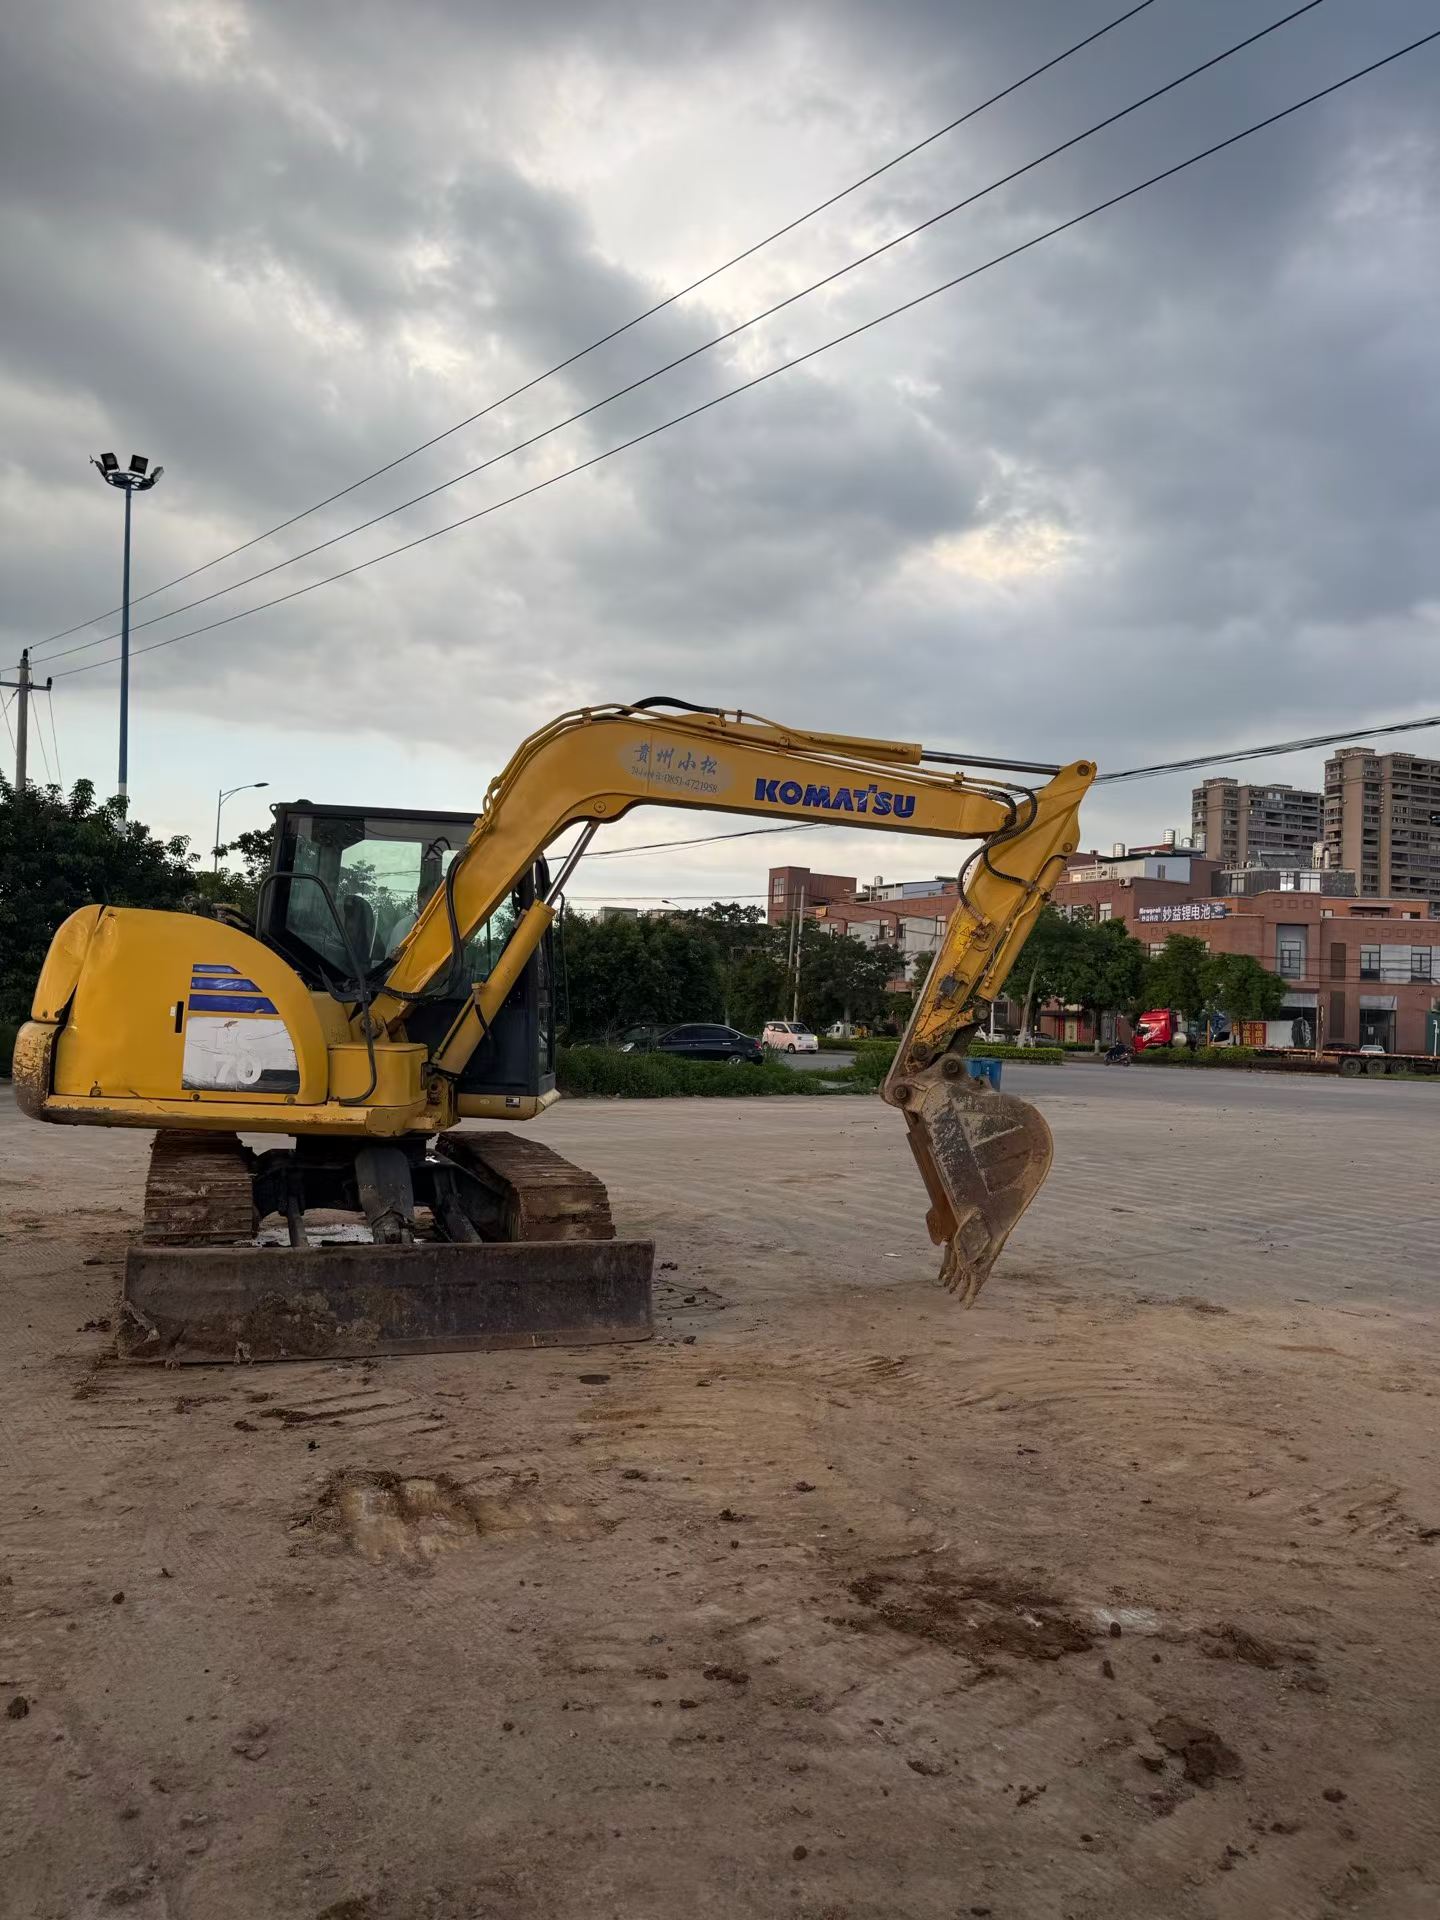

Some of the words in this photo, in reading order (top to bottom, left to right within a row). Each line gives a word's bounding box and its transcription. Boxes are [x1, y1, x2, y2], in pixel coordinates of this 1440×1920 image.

[633, 743, 718, 775] 贵州小松
[754, 778, 916, 818] KOMATSU
[1162, 903, 1211, 922] 妙益锂电池
[213, 1054, 262, 1085] 70
